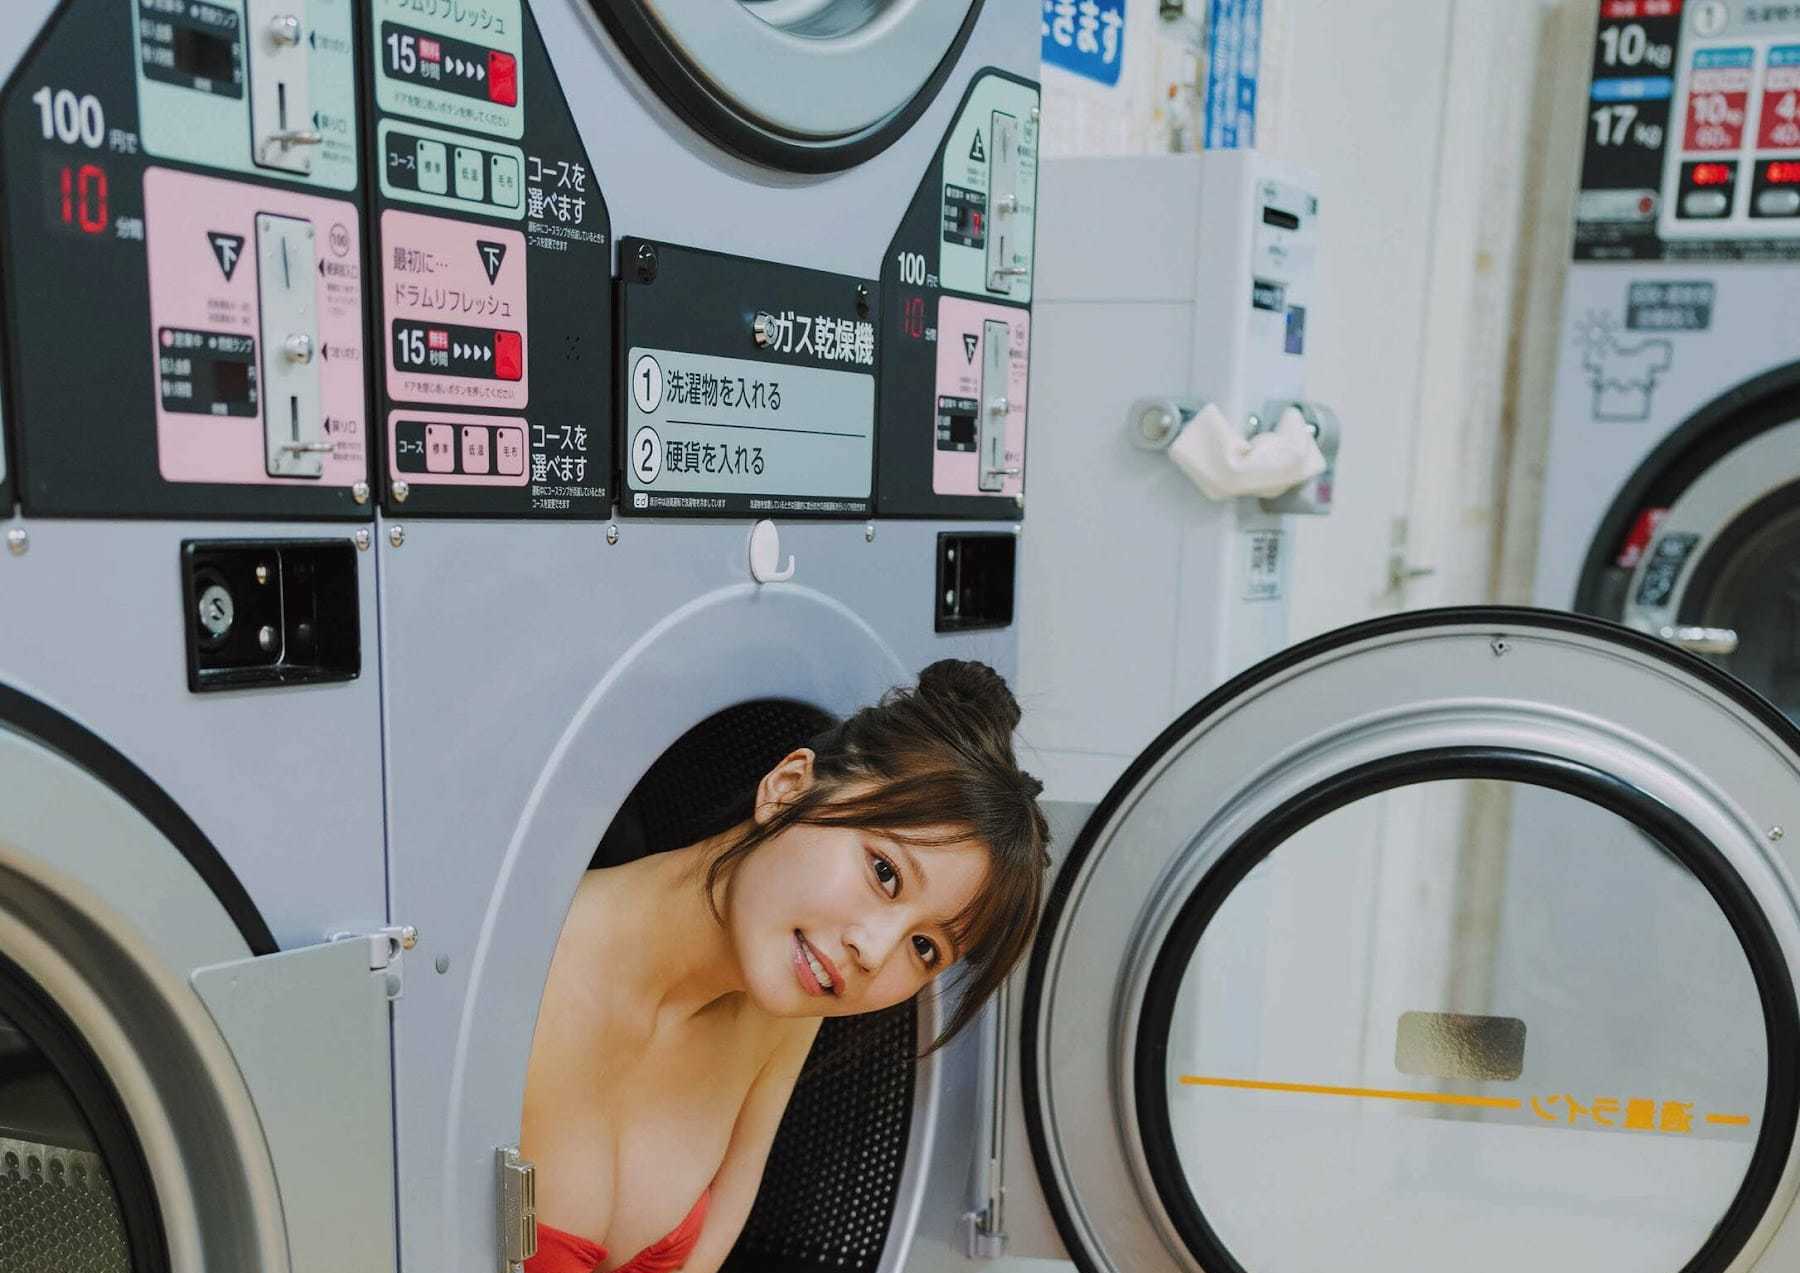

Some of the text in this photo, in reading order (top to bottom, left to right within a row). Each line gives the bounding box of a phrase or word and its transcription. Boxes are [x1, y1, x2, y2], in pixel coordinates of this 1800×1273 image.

[387, 33, 416, 74] 15
[33, 85, 105, 148] 100
[390, 152, 417, 170] コース
[528, 156, 587, 192] コースを
[60, 164, 108, 234] 10
[527, 187, 586, 224] 選べます
[215, 238, 239, 272] 下
[484, 246, 500, 276] 下
[898, 251, 926, 286] 100
[394, 282, 512, 317] ドラムリフレッシュ
[398, 328, 425, 365] 15
[774, 311, 875, 366] ガス乾燥機
[666, 369, 782, 411] 洗濯物を入れる
[399, 440, 424, 454] コース
[532, 424, 588, 451] コースを
[531, 454, 588, 482] 選べます
[666, 441, 765, 475] 硬貨を入れる
